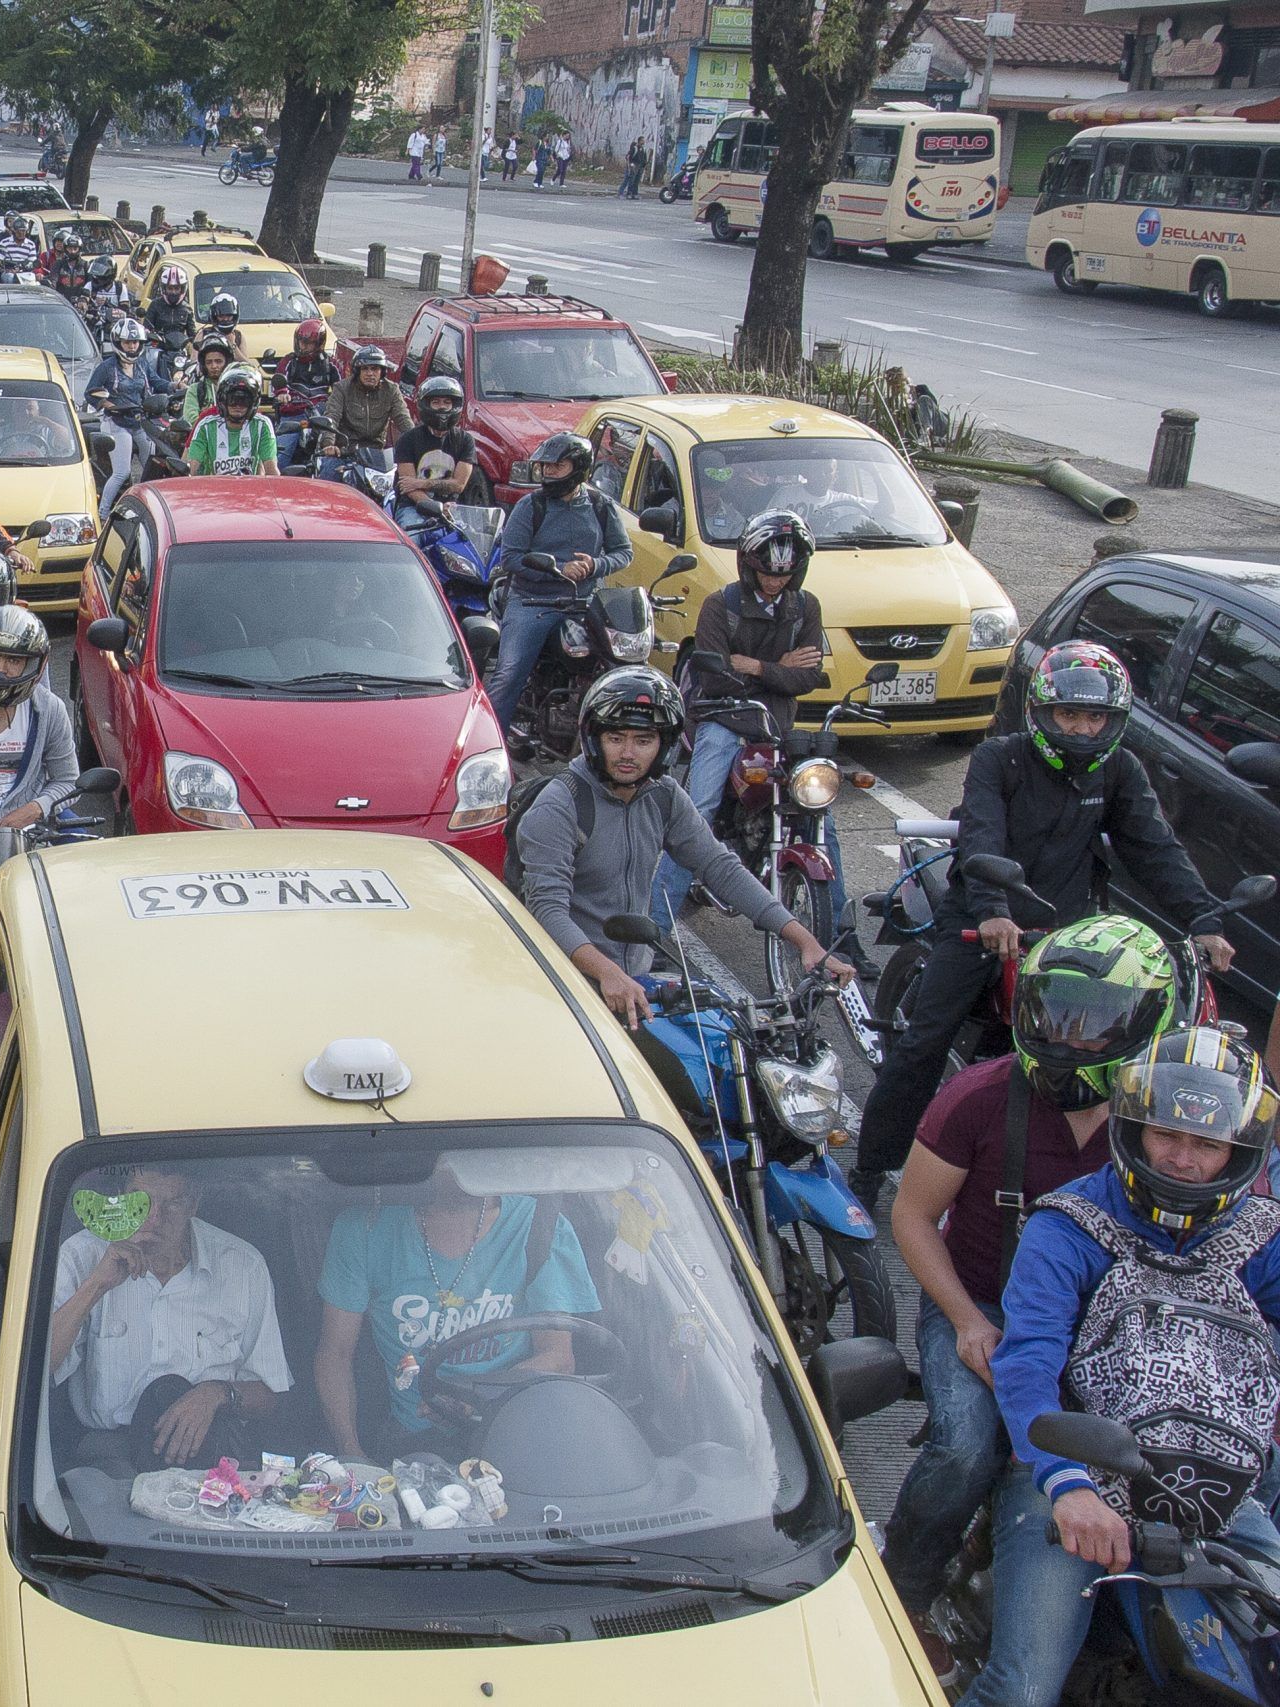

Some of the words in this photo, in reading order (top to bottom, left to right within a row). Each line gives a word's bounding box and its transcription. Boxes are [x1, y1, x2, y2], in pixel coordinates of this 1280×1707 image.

[923, 136, 988, 151] BELLO
[940, 186, 962, 198] 150
[1073, 692, 1105, 701] SHAFT
[623, 705, 654, 714] SHAFT
[198, 870, 311, 882] MEDELLIN
[343, 1072, 384, 1090] TAXI
